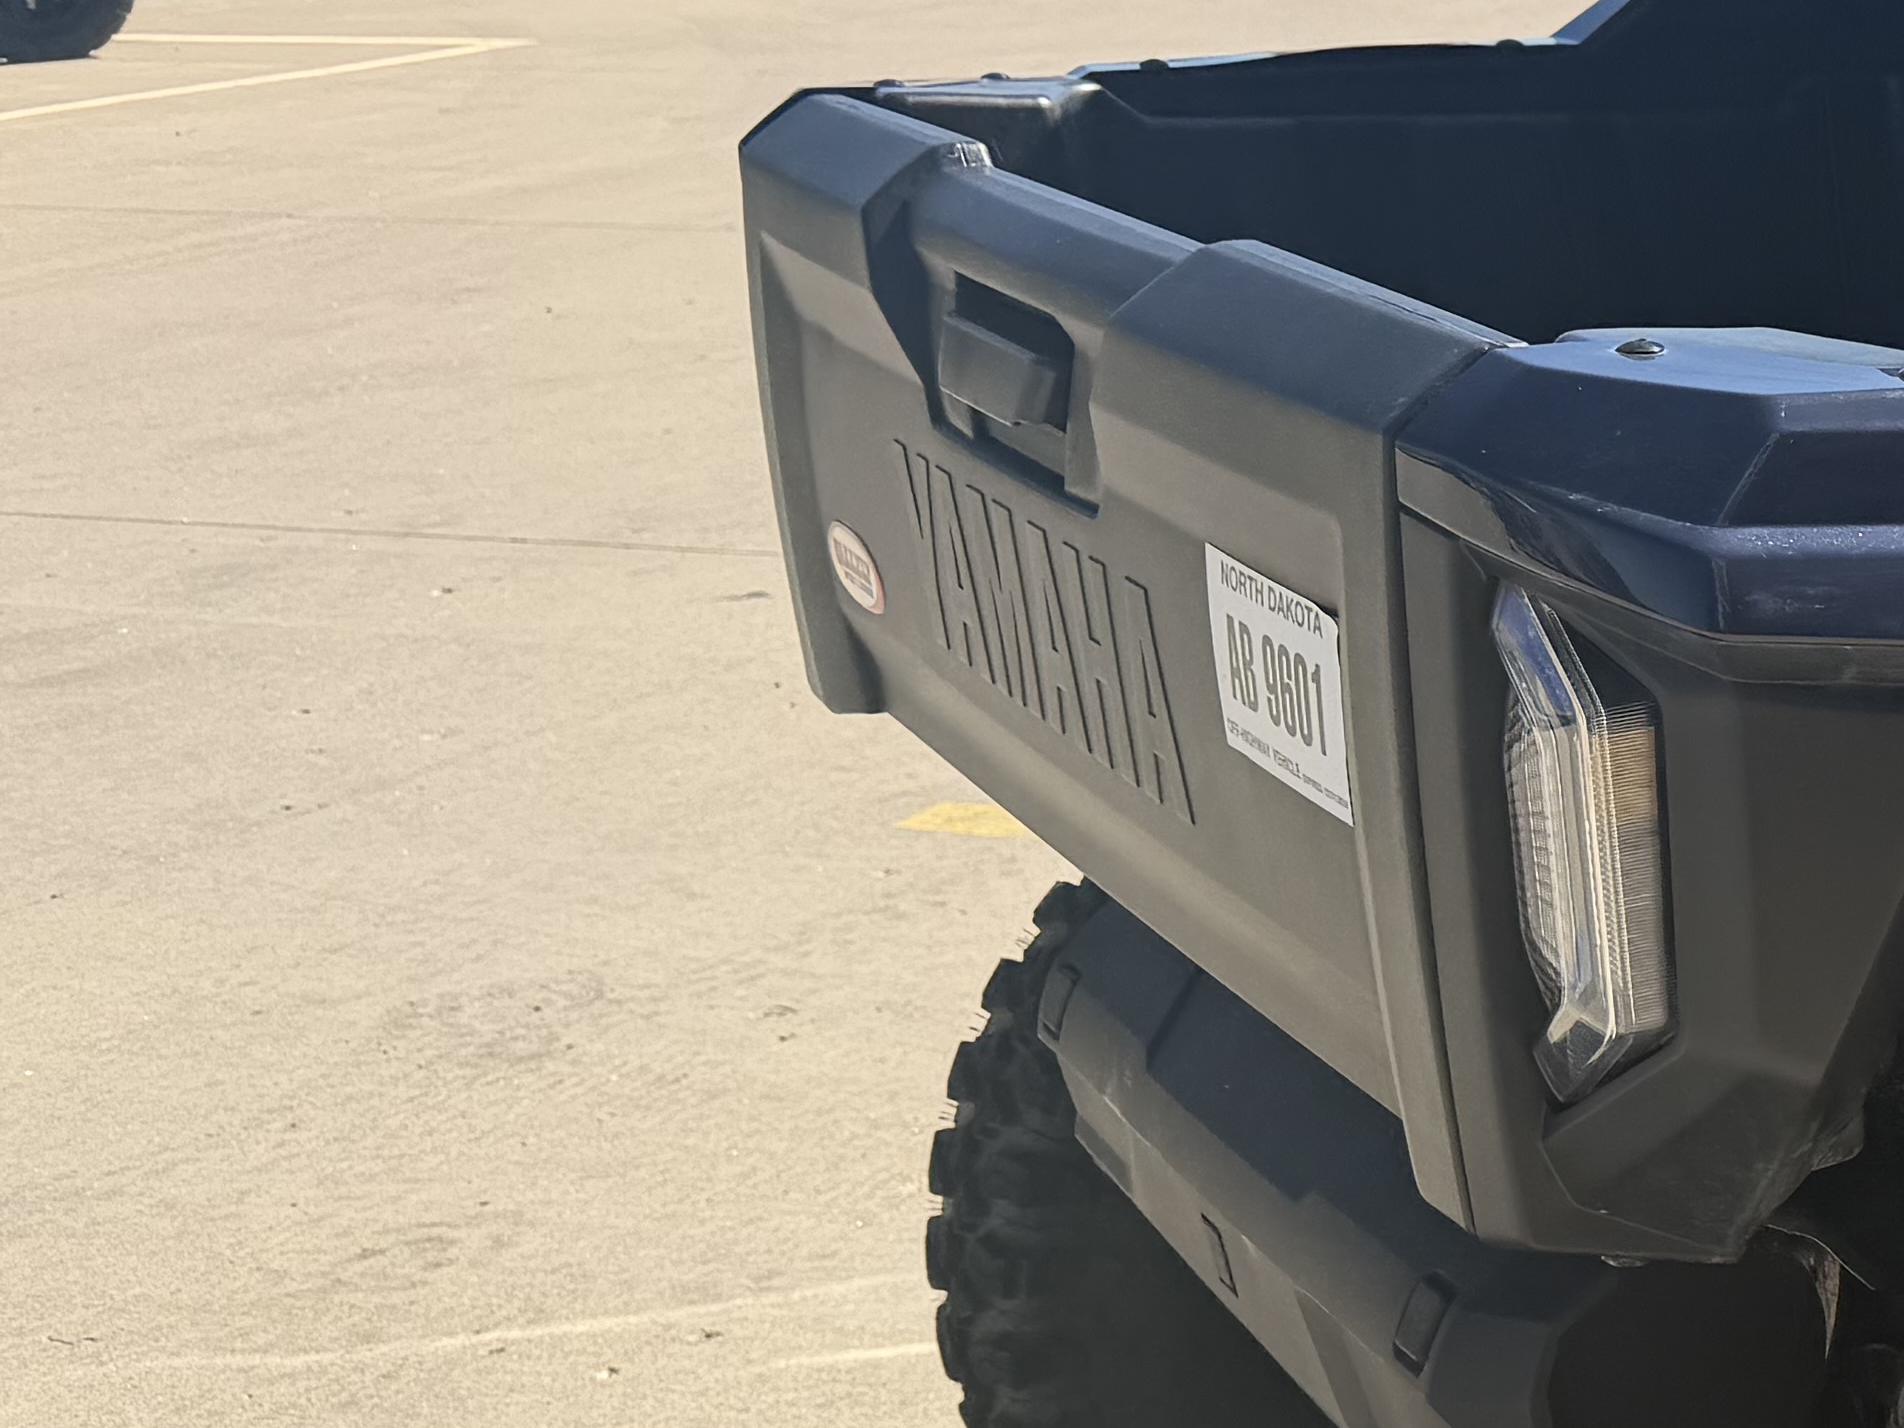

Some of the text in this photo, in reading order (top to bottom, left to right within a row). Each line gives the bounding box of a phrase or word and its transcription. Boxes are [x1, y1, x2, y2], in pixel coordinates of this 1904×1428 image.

[893, 438, 1195, 826] YAMAHA
[1221, 560, 1323, 638] NORTH DAKOTA
[1226, 614, 1327, 756] AB 9601
